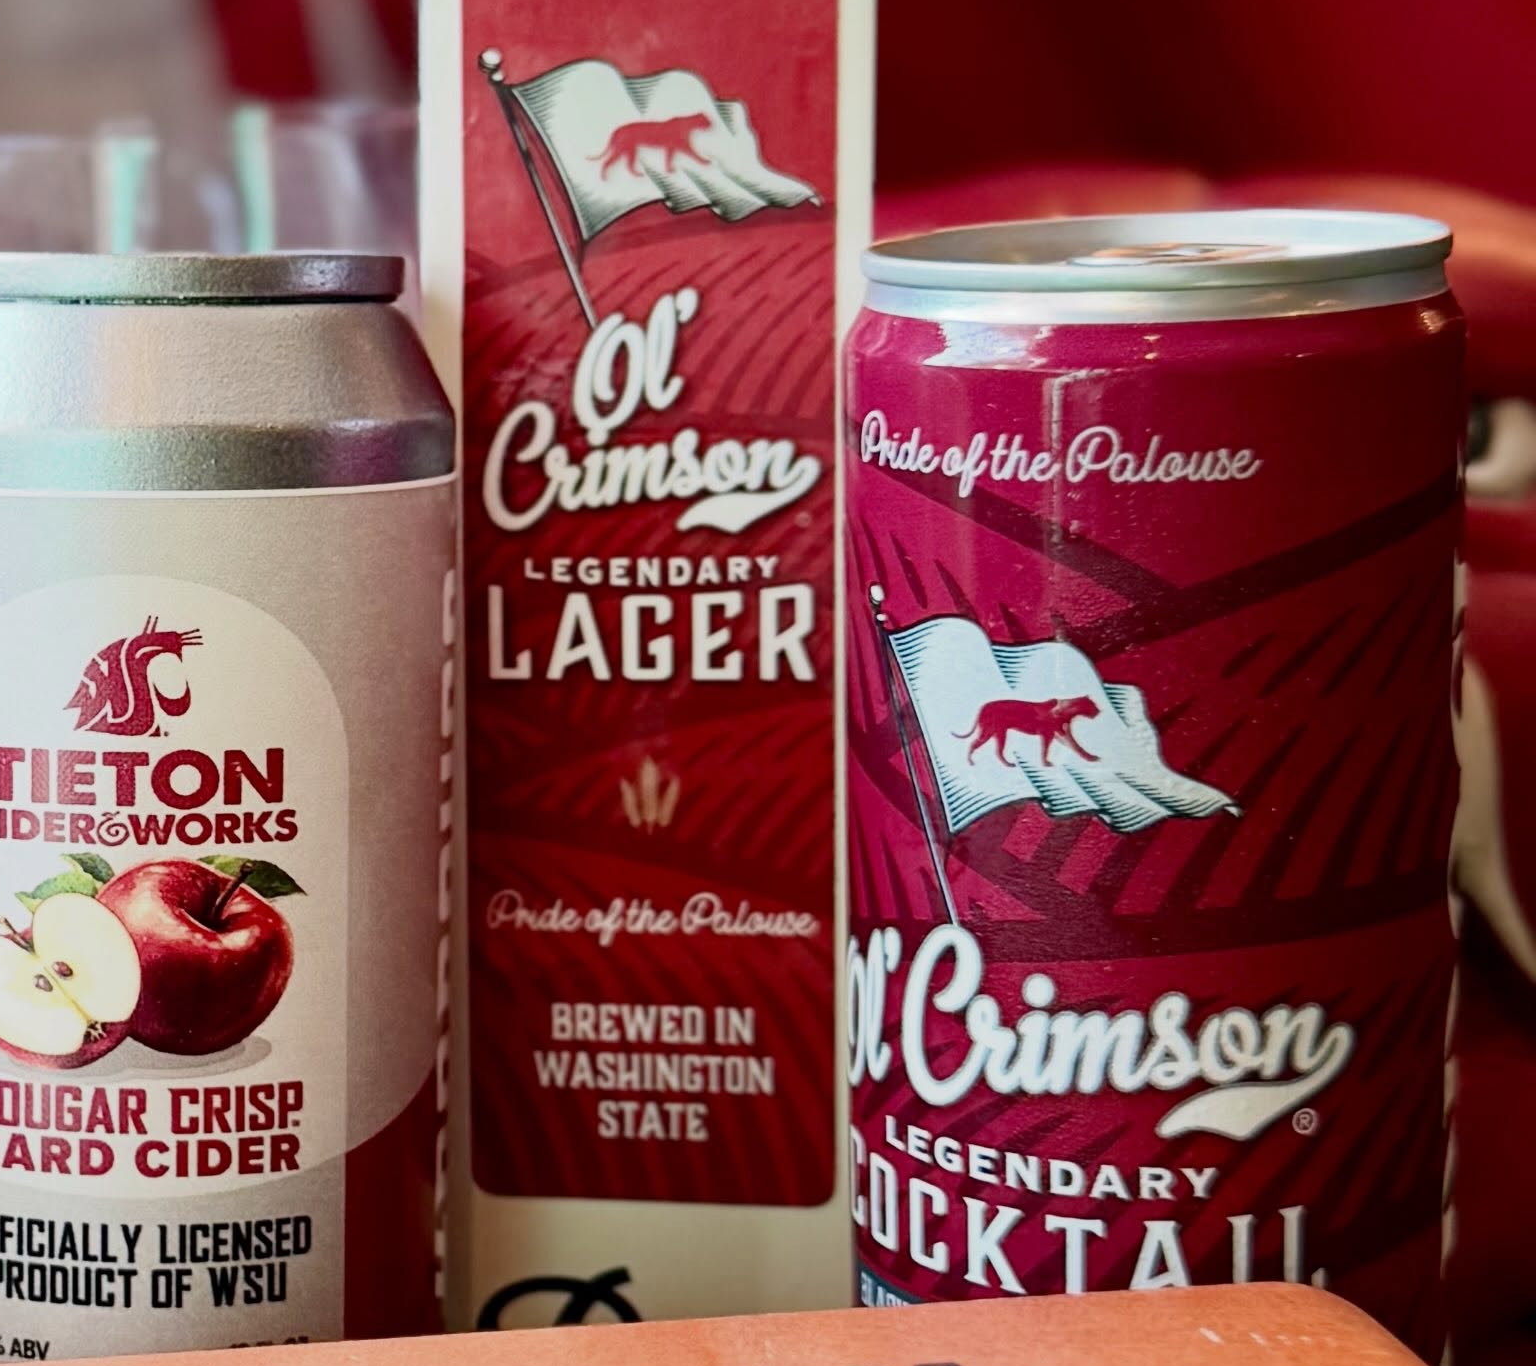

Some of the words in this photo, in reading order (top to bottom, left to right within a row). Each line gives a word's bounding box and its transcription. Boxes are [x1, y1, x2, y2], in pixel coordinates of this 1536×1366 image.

[572, 287, 700, 445] Ol'
[482, 401, 822, 533] Crimson
[860, 410, 940, 474] Pride
[941, 432, 988, 498] of
[989, 433, 1062, 483] the
[1066, 426, 1264, 484] Palouse
[524, 556, 779, 587] LEGENDARY
[488, 583, 816, 682] LAGER
[487, 889, 581, 932] Pride
[584, 897, 626, 947] of
[625, 899, 678, 934] the
[681, 892, 819, 937] Palouse
[551, 1003, 705, 1044] BREWED
[715, 1007, 755, 1045] IN
[901, 923, 1355, 1140] Crimson
[534, 1051, 774, 1095] WASHINGTON
[598, 1102, 708, 1140] STATE
[134, 1133, 300, 1178] CIDER
[884, 1115, 1219, 1201] LEGENDARY
[158, 1216, 312, 1264] LICENSED
[151, 1268, 193, 1308] OF
[209, 1261, 287, 1307] WSU
[9, 1338, 50, 1361] ABV
